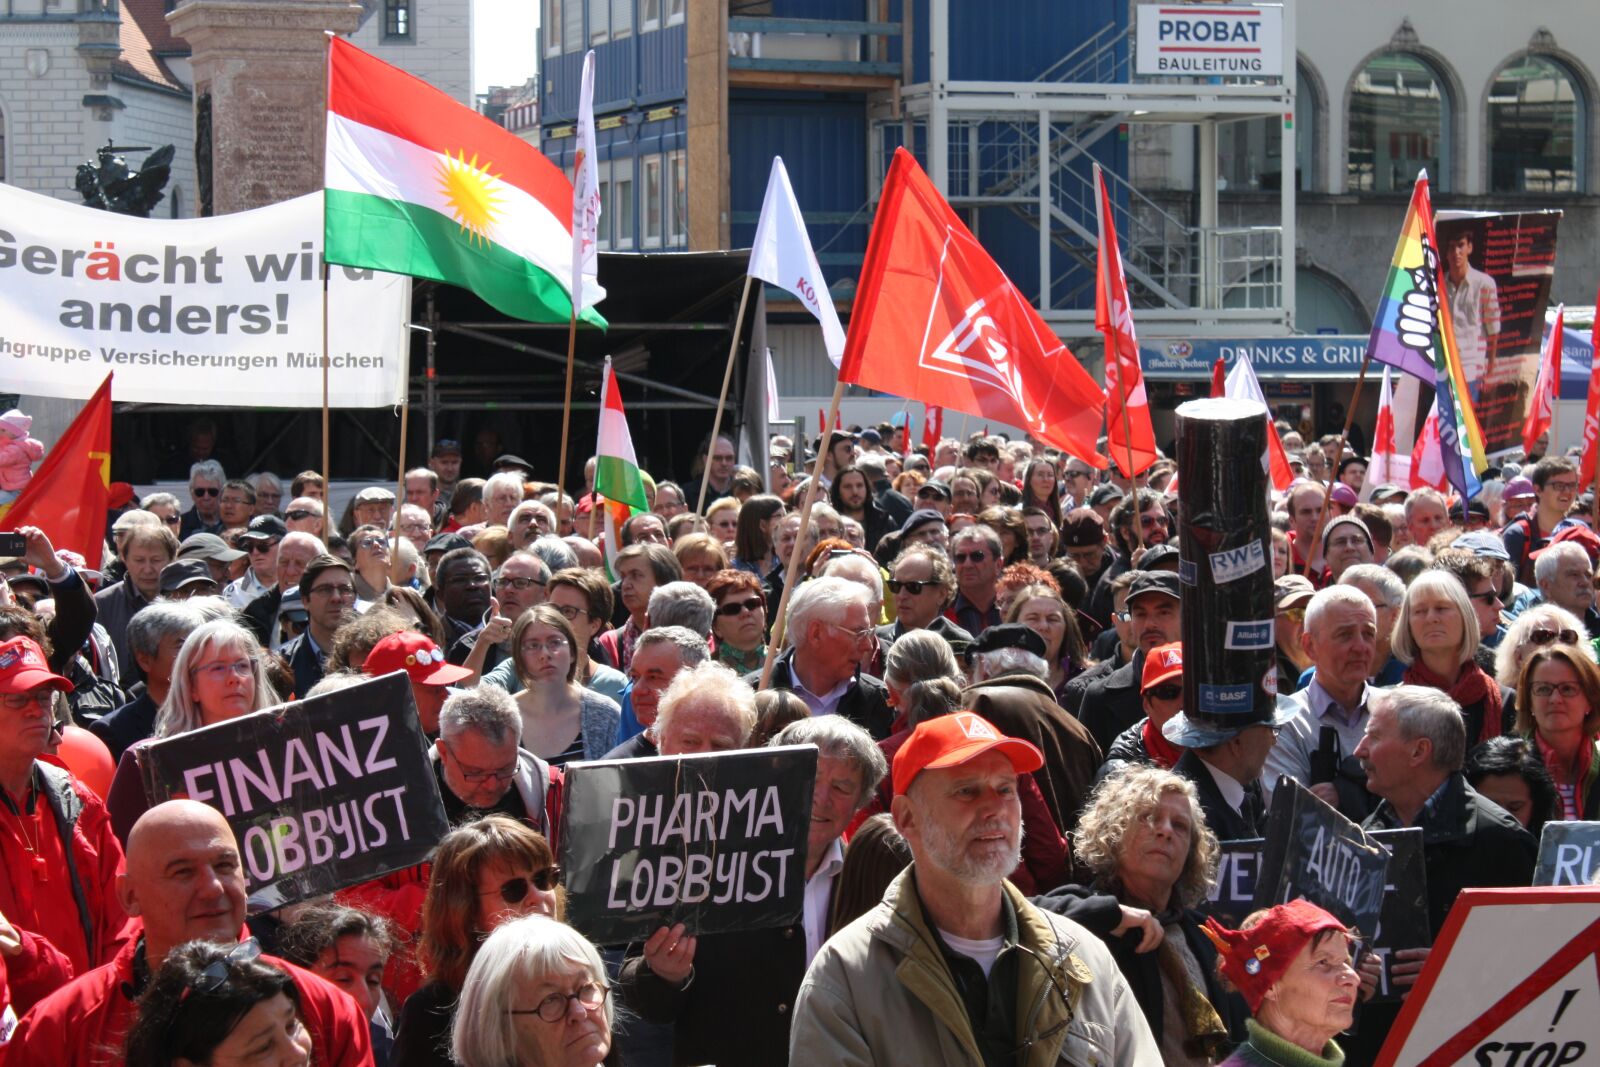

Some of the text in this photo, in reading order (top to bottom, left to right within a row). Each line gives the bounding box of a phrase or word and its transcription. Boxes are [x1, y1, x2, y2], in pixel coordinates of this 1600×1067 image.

[1159, 20, 1261, 42] PROBAT
[1158, 57, 1262, 71] BAULEITUNG
[0, 228, 223, 284] Gerächt
[58, 293, 290, 335] anders!
[100, 347, 278, 371] Versicherungen
[286, 351, 384, 368] München
[1301, 346, 1317, 364] &
[1211, 539, 1264, 571] RWE
[1237, 631, 1260, 639] Allianz
[1220, 691, 1247, 702] BASF
[183, 714, 398, 817] FINANZ
[608, 785, 785, 849] PHARMA
[243, 785, 410, 887] OBBYIST
[607, 848, 795, 909] LOBBYIST
[1307, 825, 1361, 910] AUTO
